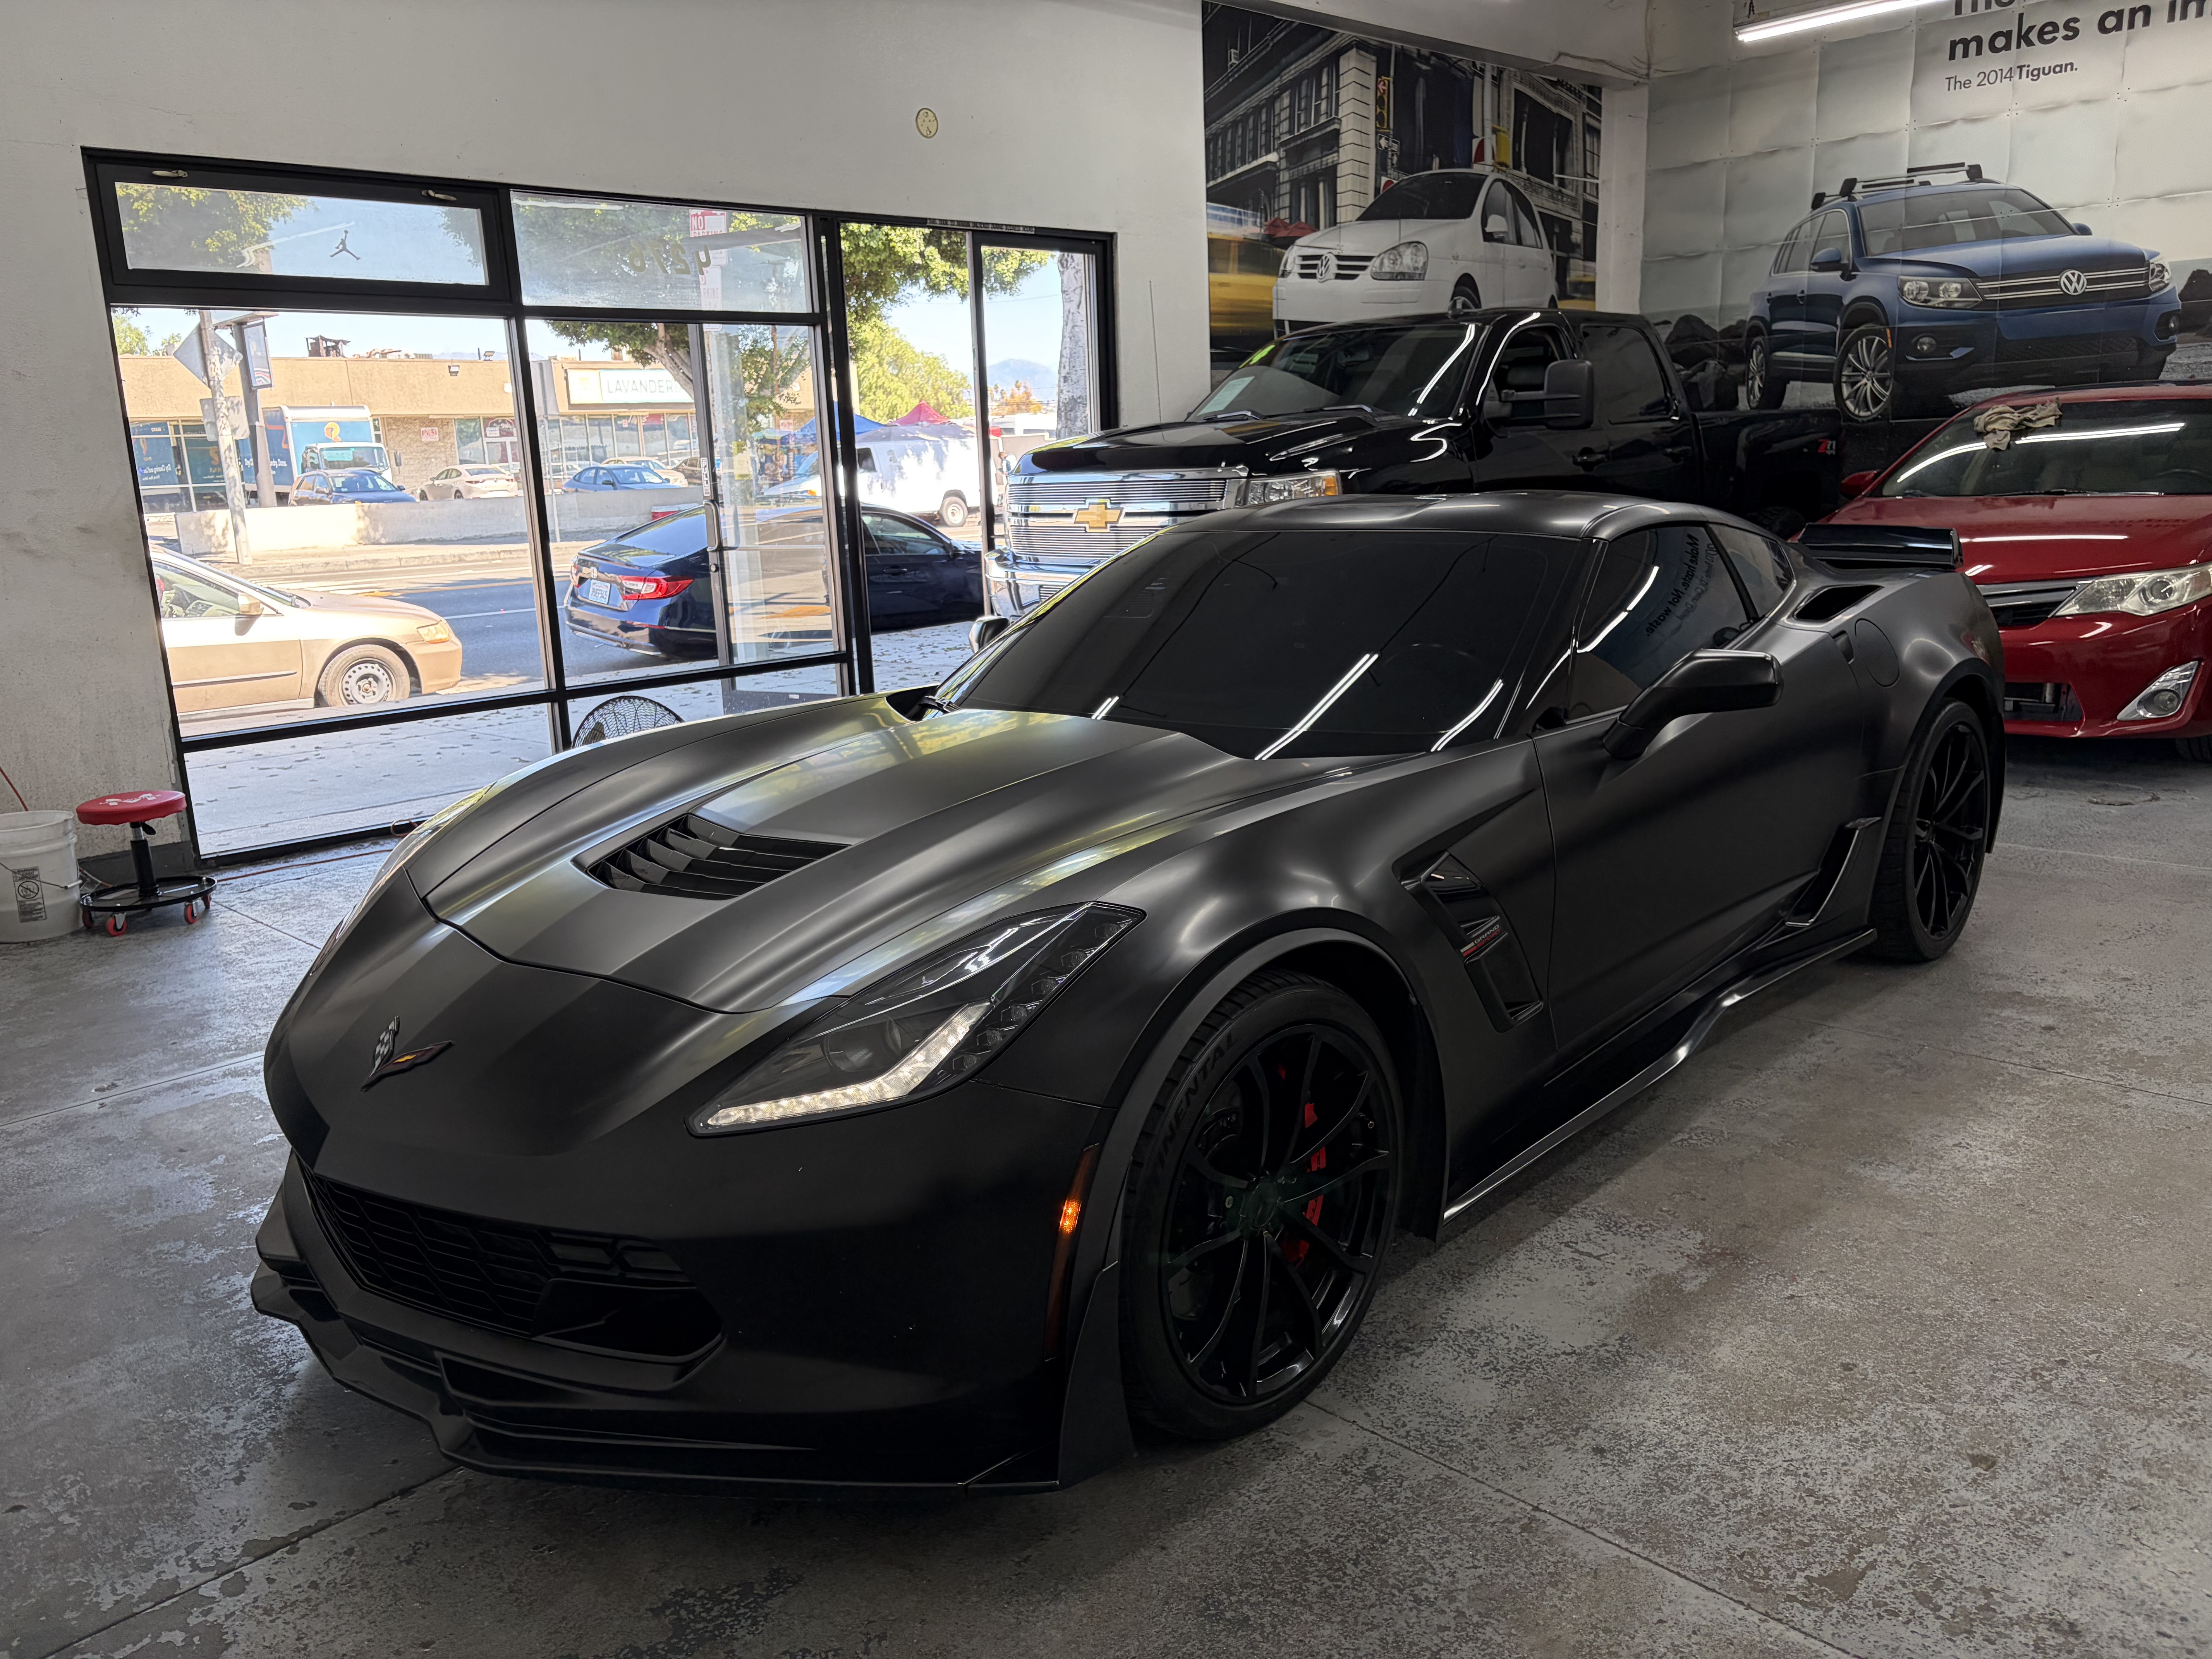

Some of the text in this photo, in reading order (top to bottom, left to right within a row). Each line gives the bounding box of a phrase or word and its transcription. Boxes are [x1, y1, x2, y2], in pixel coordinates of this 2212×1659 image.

[1949, 12, 2081, 61] makes
[2097, 5, 2152, 35] an
[1946, 60, 2078, 92] The 2014 Tiguan.
[692, 215, 704, 231] NO
[1474, 924, 1500, 944] GRAND
